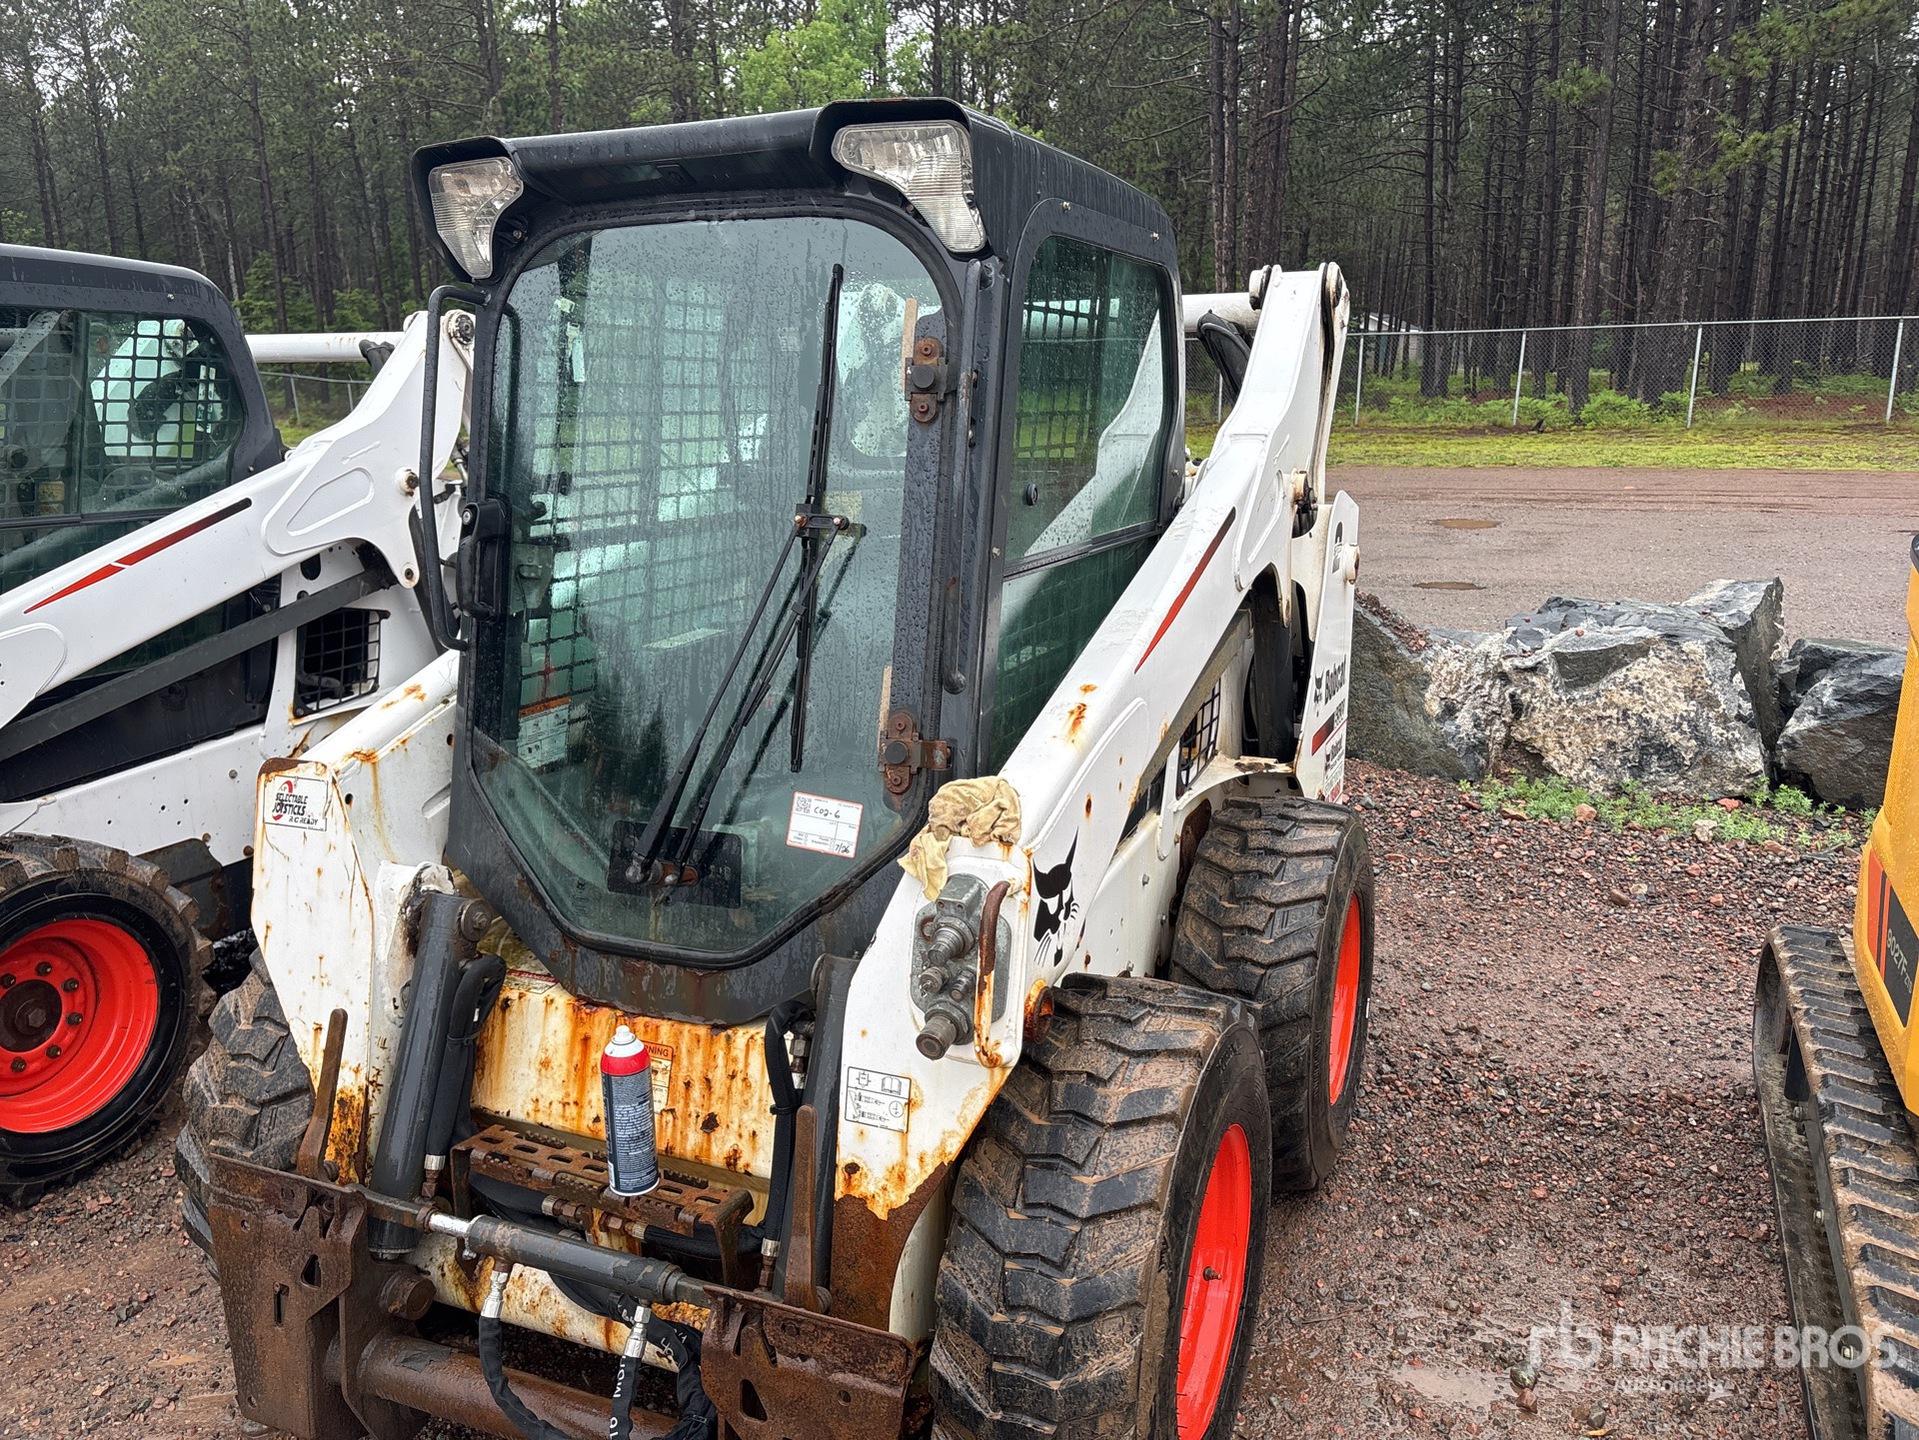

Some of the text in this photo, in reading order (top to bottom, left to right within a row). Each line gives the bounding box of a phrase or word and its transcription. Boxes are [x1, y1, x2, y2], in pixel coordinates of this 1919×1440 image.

[275, 792, 308, 804] SELECTABLE
[272, 802, 306, 816] JOYSTICKS
[300, 816, 318, 825] READY
